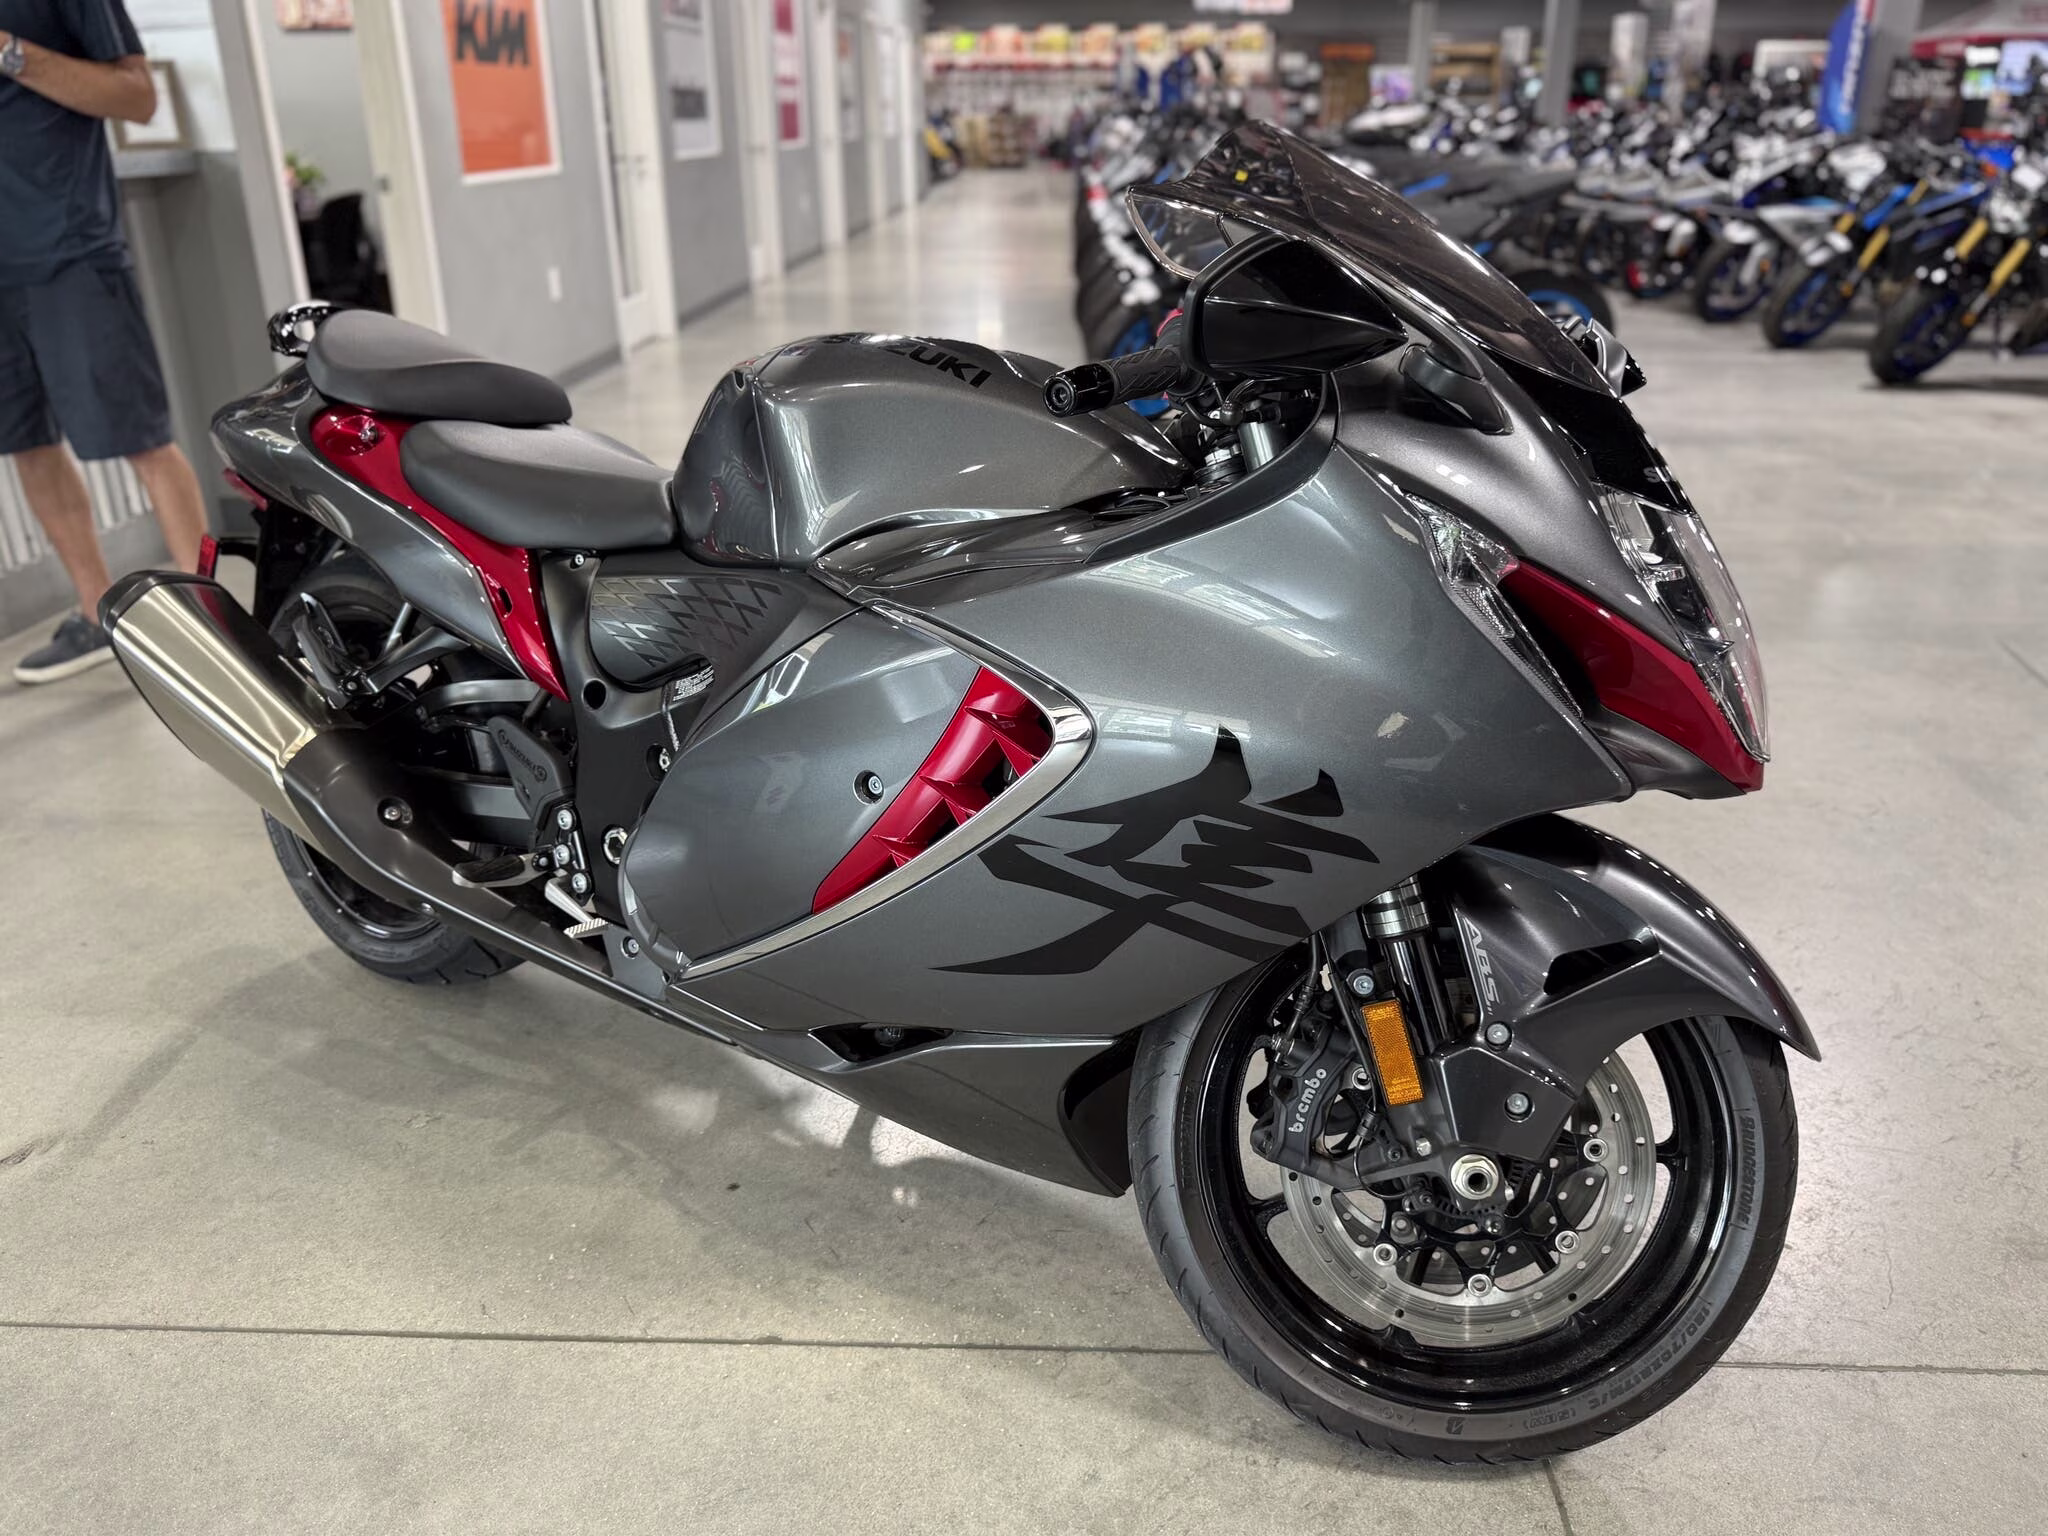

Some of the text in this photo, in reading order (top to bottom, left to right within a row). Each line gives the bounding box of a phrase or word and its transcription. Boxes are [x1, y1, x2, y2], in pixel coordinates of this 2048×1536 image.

[928, 724, 1380, 975] 隼
[1463, 917, 1500, 1006] ABS
[1288, 1068, 1326, 1133] brembo
[1738, 1115, 1756, 1225] BRIDGESTONE
